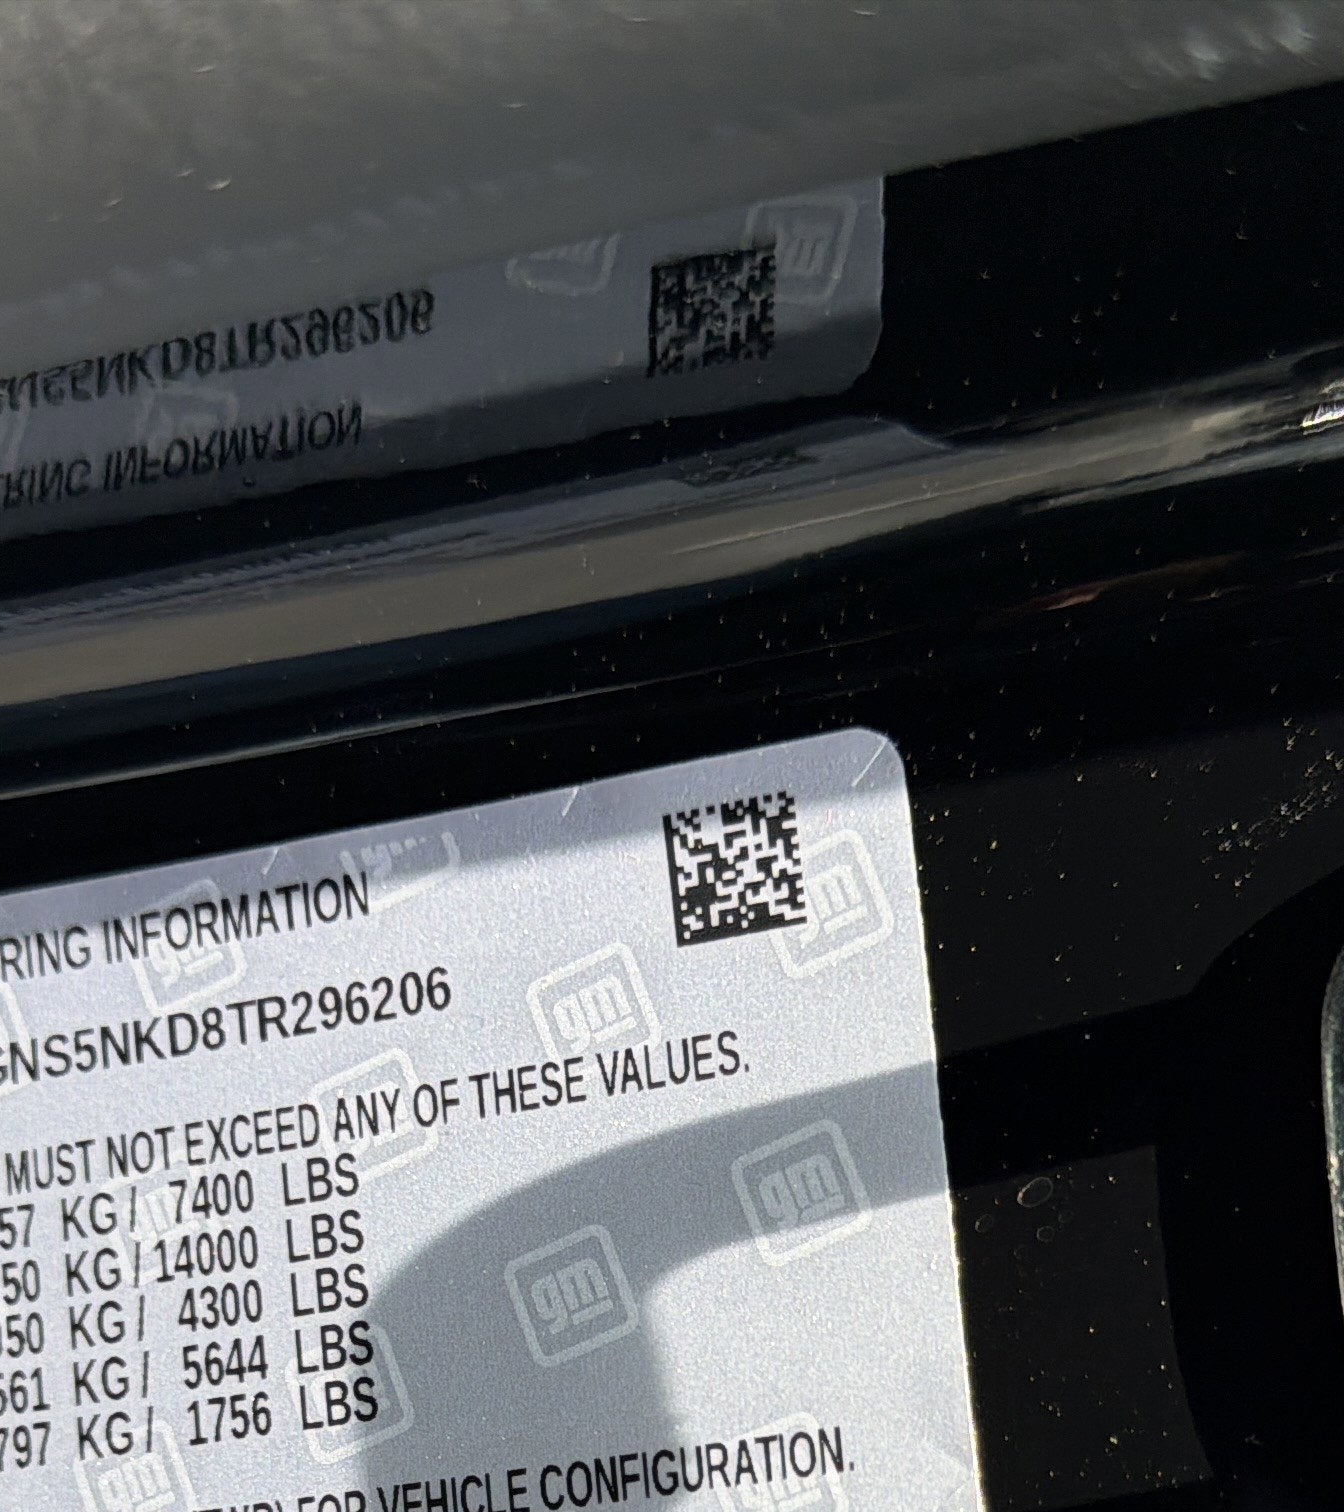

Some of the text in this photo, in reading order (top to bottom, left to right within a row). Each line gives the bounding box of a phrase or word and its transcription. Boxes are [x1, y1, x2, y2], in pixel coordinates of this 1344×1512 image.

[103, 871, 369, 963] INFORMATION
[5, 1139, 95, 1193] MUST
[107, 1126, 174, 1178] NOT
[185, 1104, 319, 1165] EXCEED
[334, 1089, 400, 1142] ANY
[413, 1079, 459, 1127] OF
[469, 1056, 586, 1118] THESE
[595, 1031, 749, 1096] VALUES.
[169, 1170, 253, 1224] 7400
[282, 1153, 359, 1206] LBS
[154, 1226, 258, 1282] 14000
[286, 1210, 364, 1263] LBS
[178, 1280, 262, 1331] 4300
[291, 1264, 368, 1317] LBS
[183, 1335, 268, 1389] 5644
[295, 1321, 373, 1374] LBS
[187, 1392, 271, 1445] 1756
[300, 1377, 378, 1430] LBS
[540, 1426, 854, 1510] CONFIGURATION.
